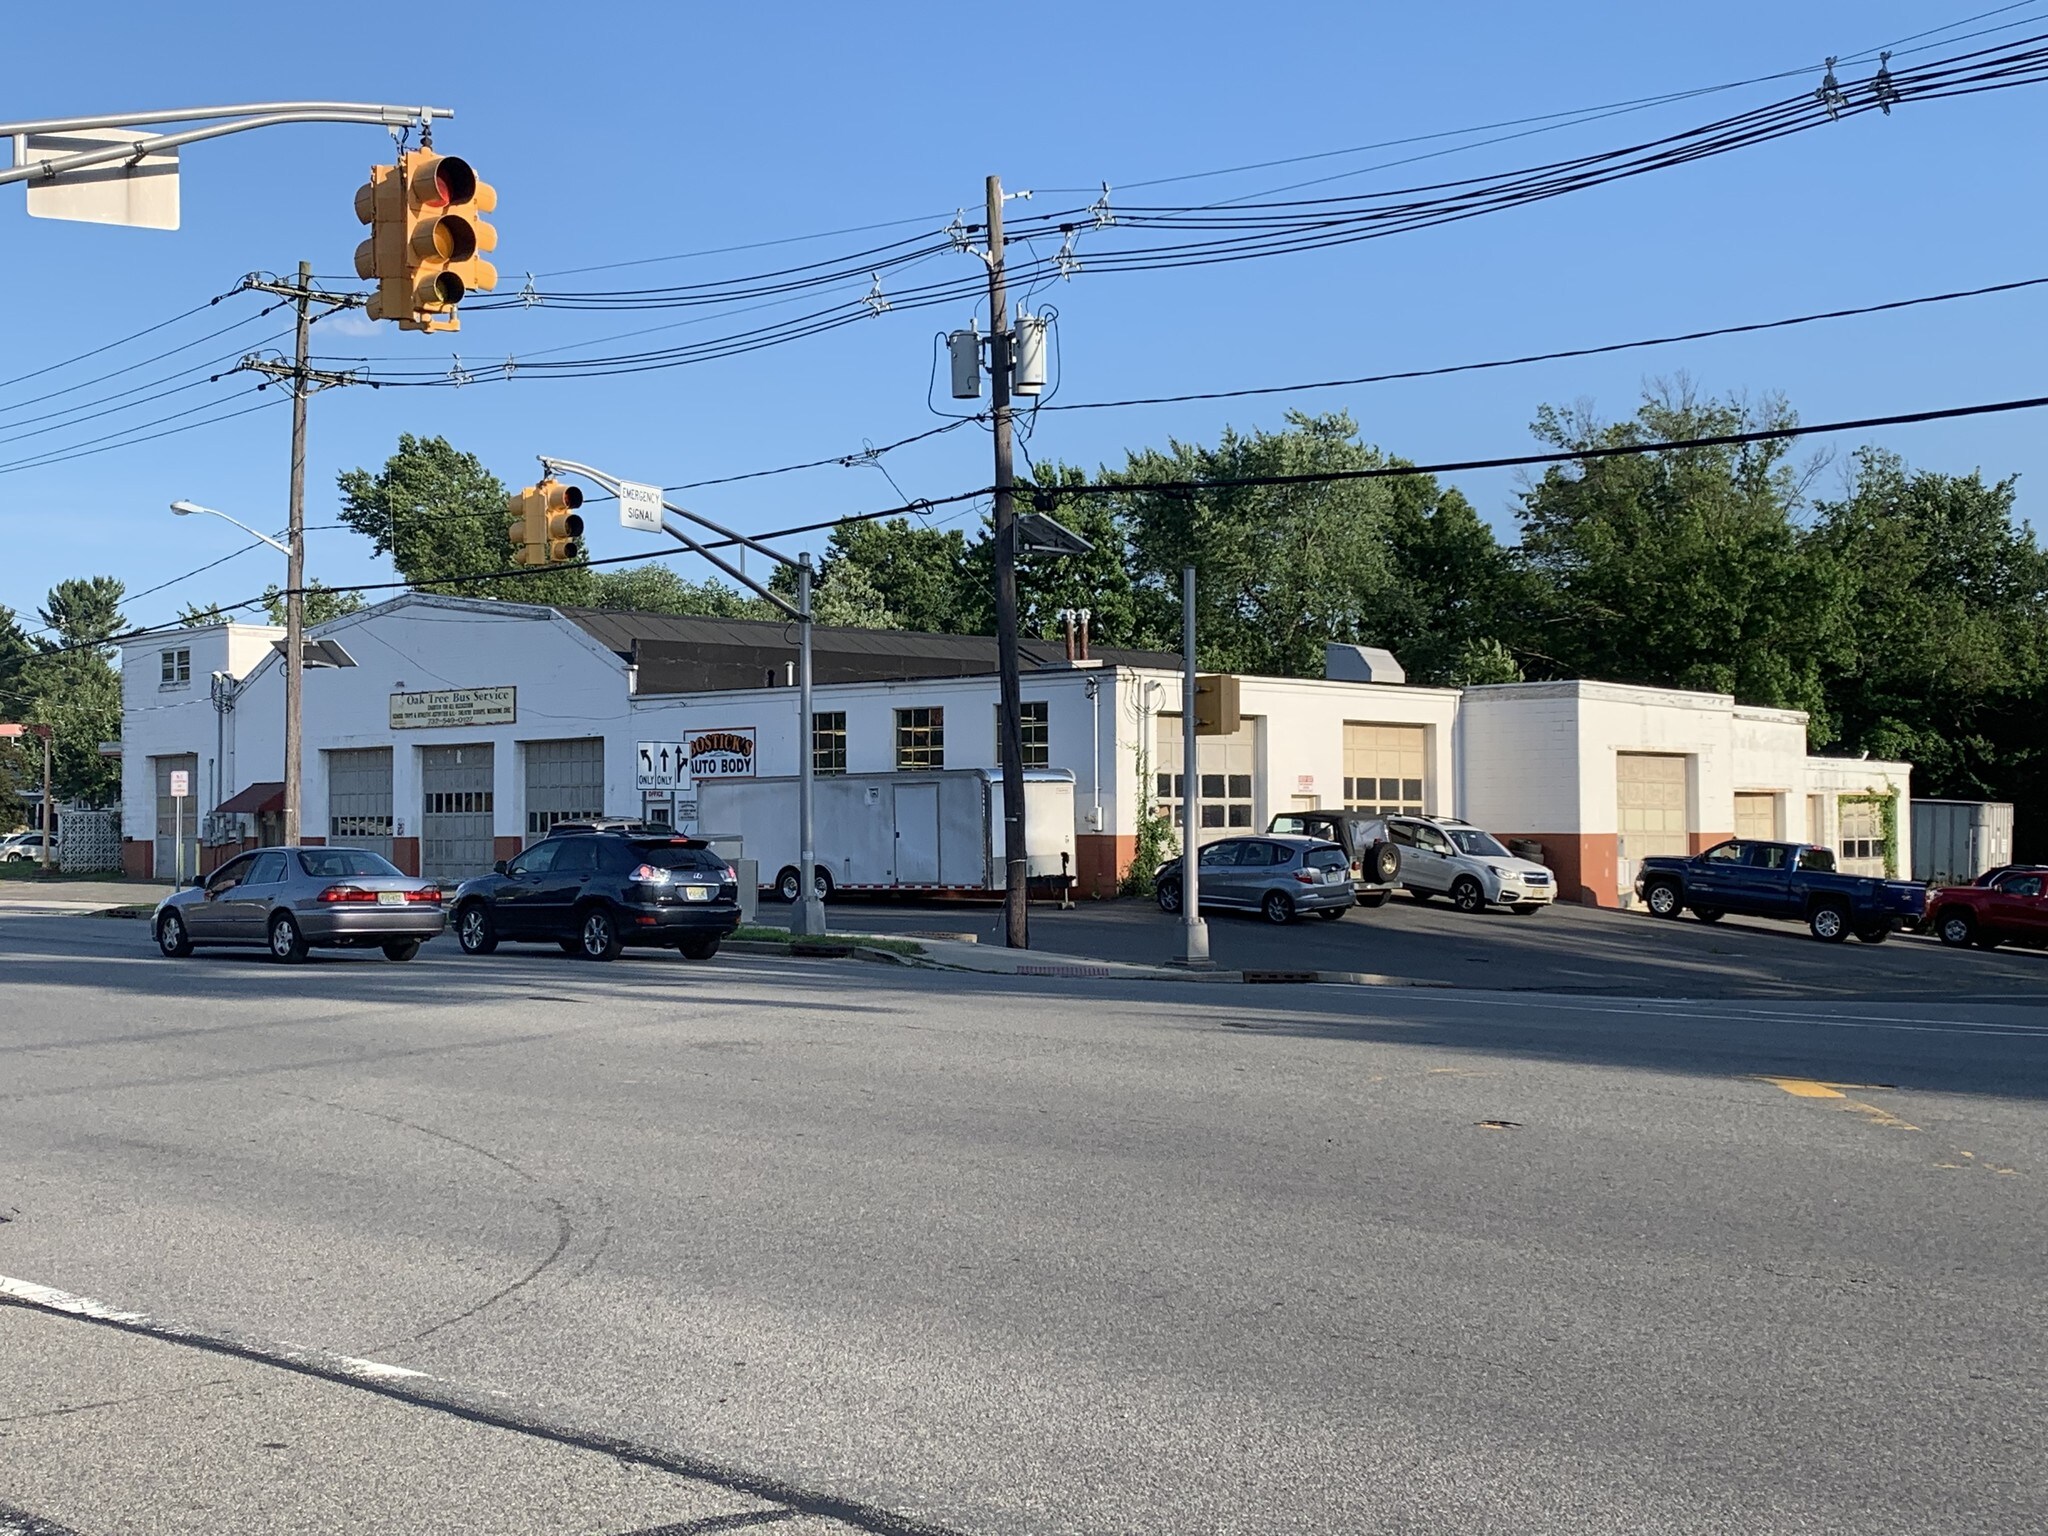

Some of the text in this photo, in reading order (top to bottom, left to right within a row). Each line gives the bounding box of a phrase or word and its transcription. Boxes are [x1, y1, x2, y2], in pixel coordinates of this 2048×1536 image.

[622, 487, 660, 504] EMERGENCY
[628, 507, 655, 522] SIGNAL
[406, 690, 509, 705] Oak Tree Bus Service
[721, 758, 752, 773] BODY
[638, 775, 655, 785] ONLY
[657, 775, 673, 785] ONLY
[648, 790, 664, 798] OFFICE
